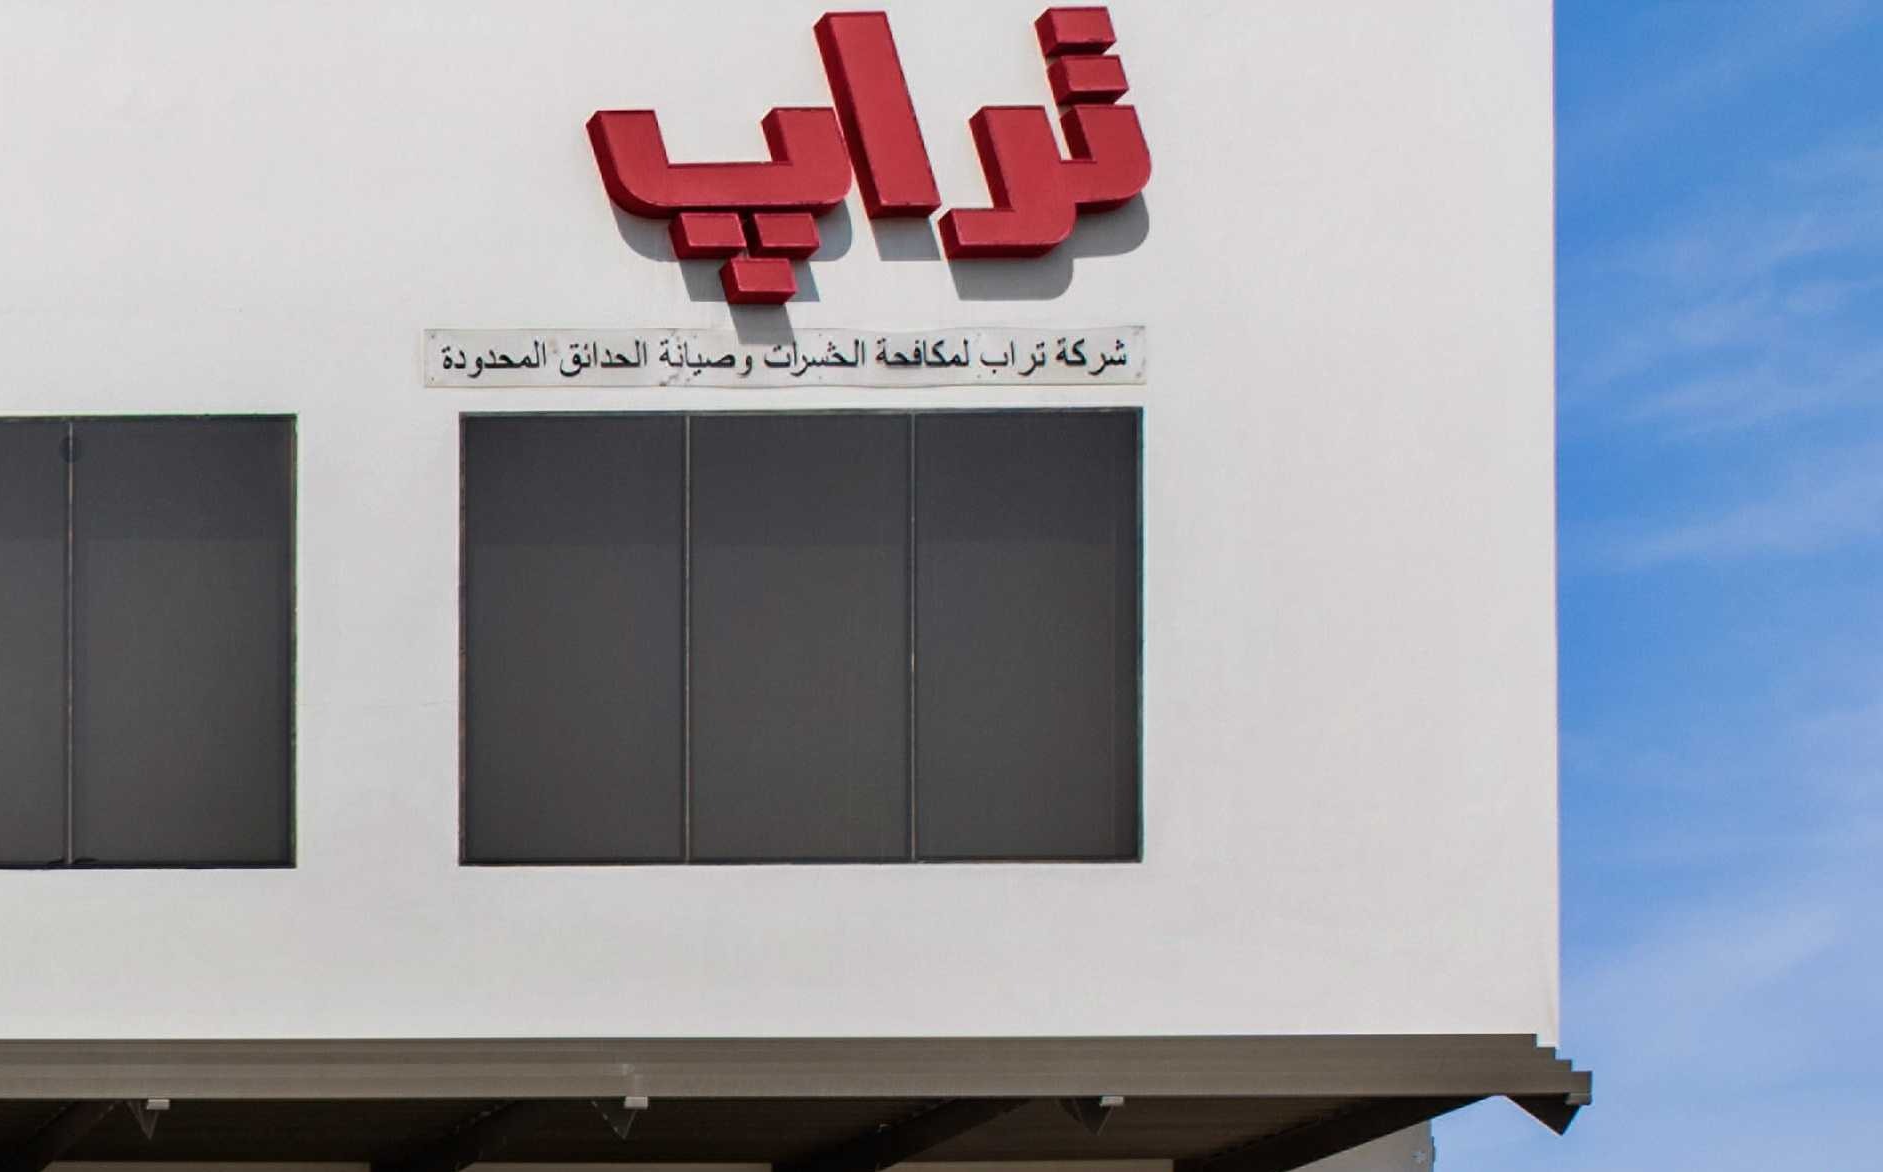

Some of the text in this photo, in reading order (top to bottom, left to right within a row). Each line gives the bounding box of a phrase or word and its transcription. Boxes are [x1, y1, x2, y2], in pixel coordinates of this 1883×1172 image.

[442, 340, 547, 378] المحدودة
[559, 340, 648, 377] الحدائق
[876, 337, 970, 368] لمكافحة
[981, 339, 1045, 375] تراب
[1056, 337, 1128, 375] شركة
